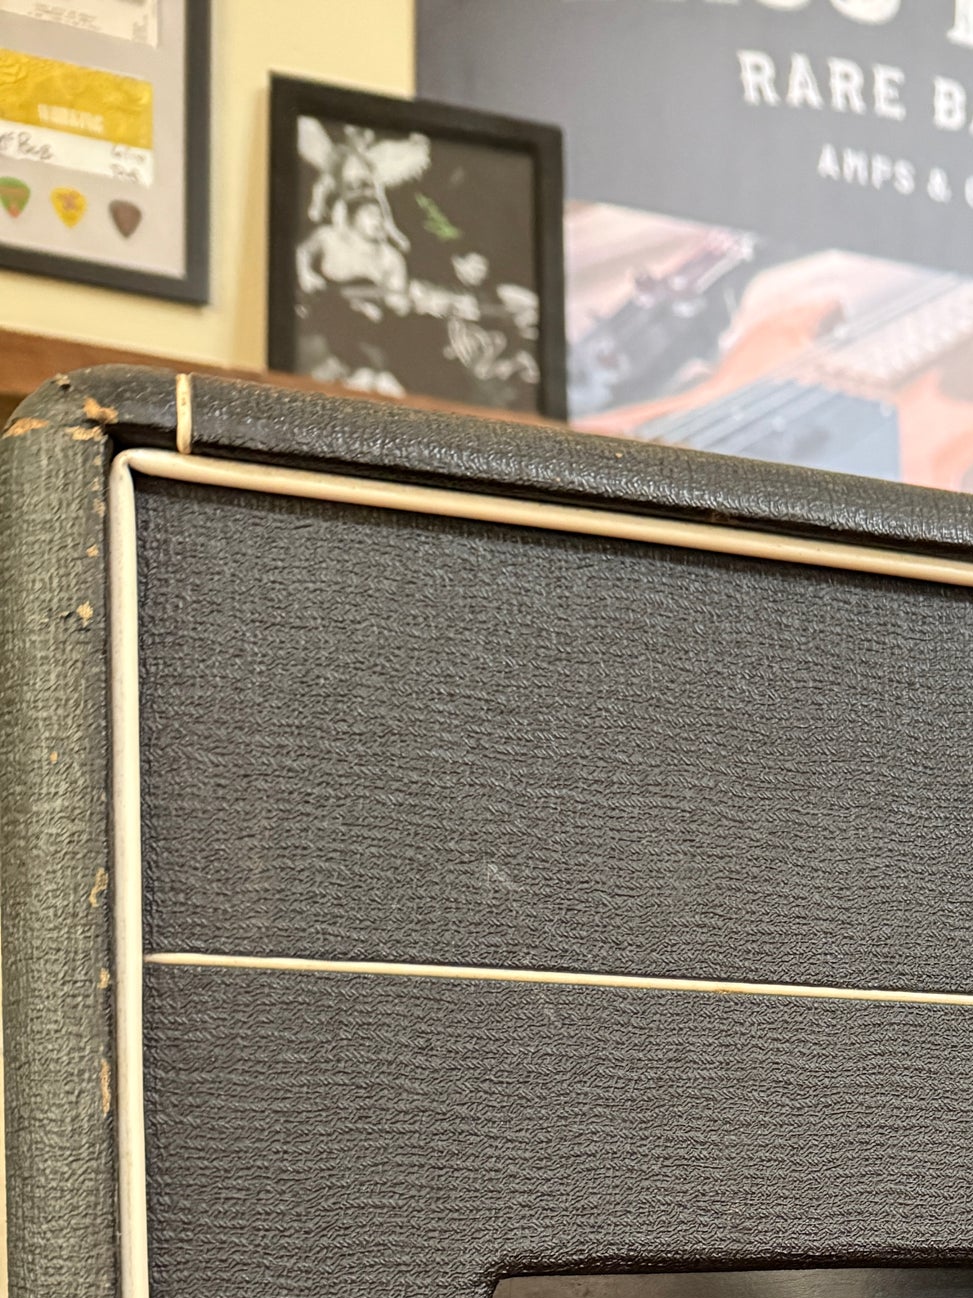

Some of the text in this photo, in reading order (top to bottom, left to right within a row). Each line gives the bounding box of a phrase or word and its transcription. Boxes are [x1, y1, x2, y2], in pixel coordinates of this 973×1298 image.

[737, 50, 906, 121] RARE
[817, 143, 915, 195] AMPS
[927, 167, 951, 203] &
